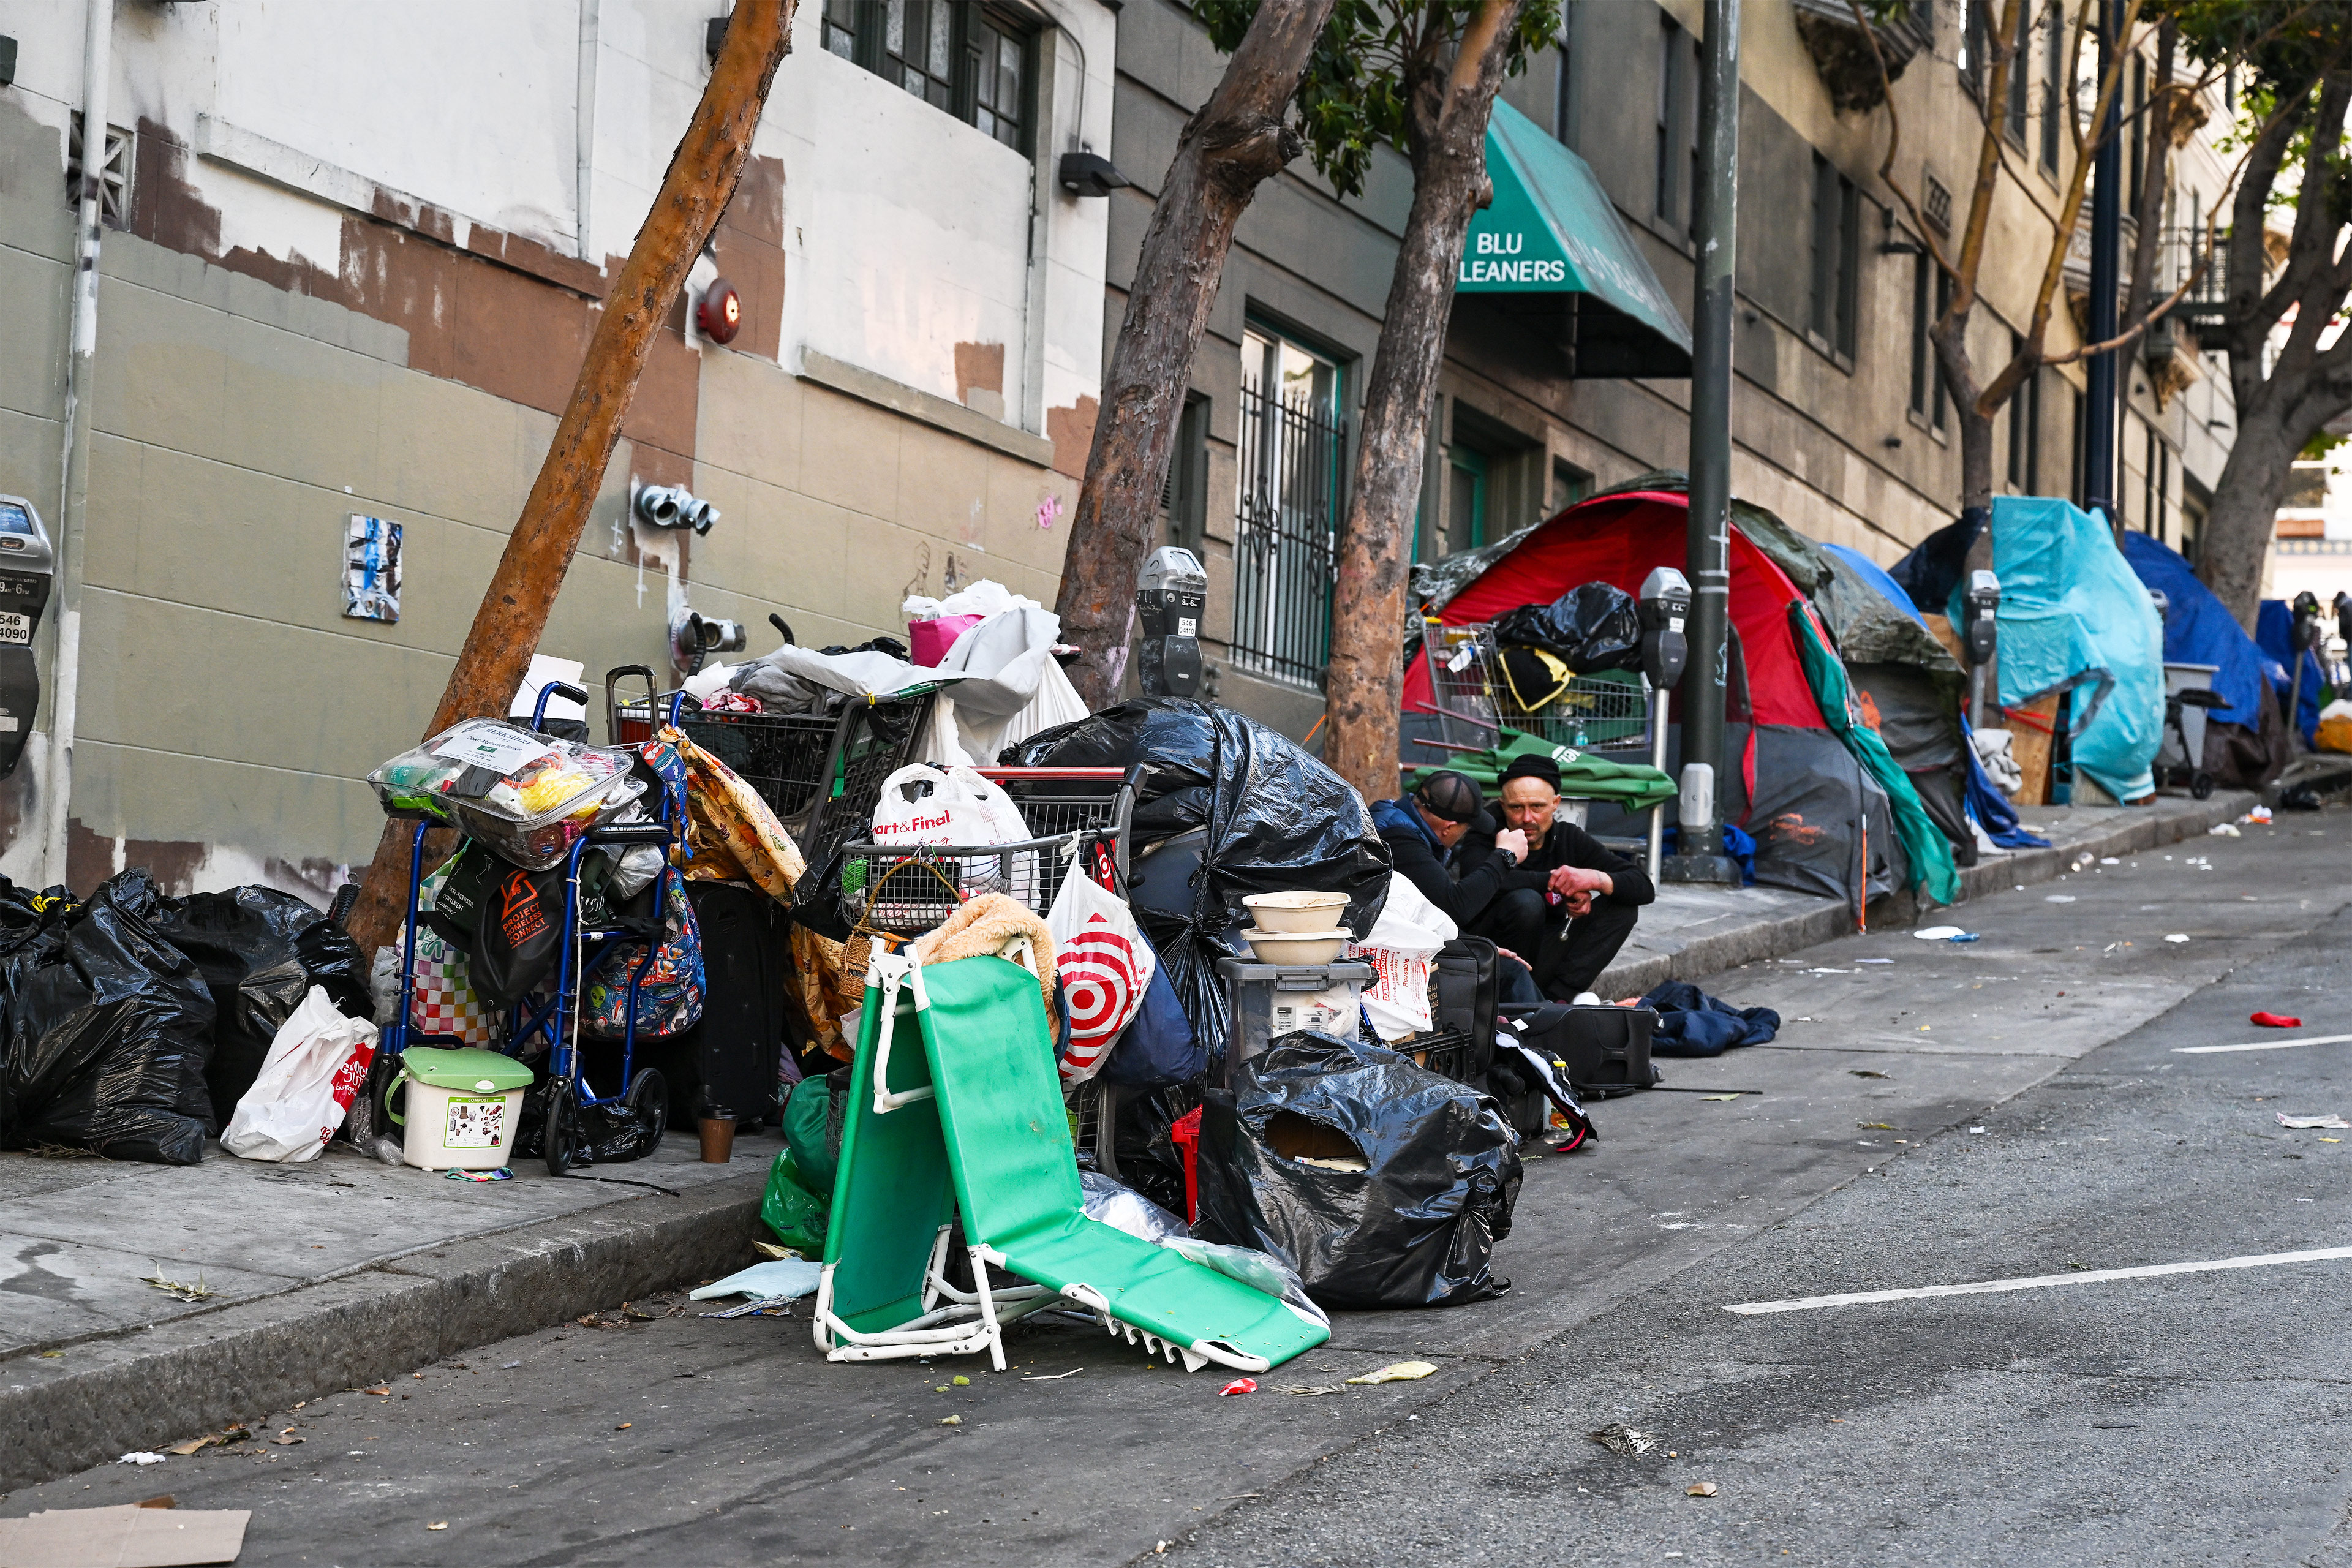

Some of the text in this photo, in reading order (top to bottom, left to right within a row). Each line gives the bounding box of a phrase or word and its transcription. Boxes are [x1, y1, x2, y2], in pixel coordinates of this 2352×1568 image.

[1477, 232, 1523, 254] BLU
[1459, 260, 1566, 282] LEANERS
[485, 728, 533, 746] BERKSHIRE
[502, 902, 540, 932] PROJECT
[506, 910, 543, 939] HOMELESS
[508, 917, 546, 945] CONNECT
